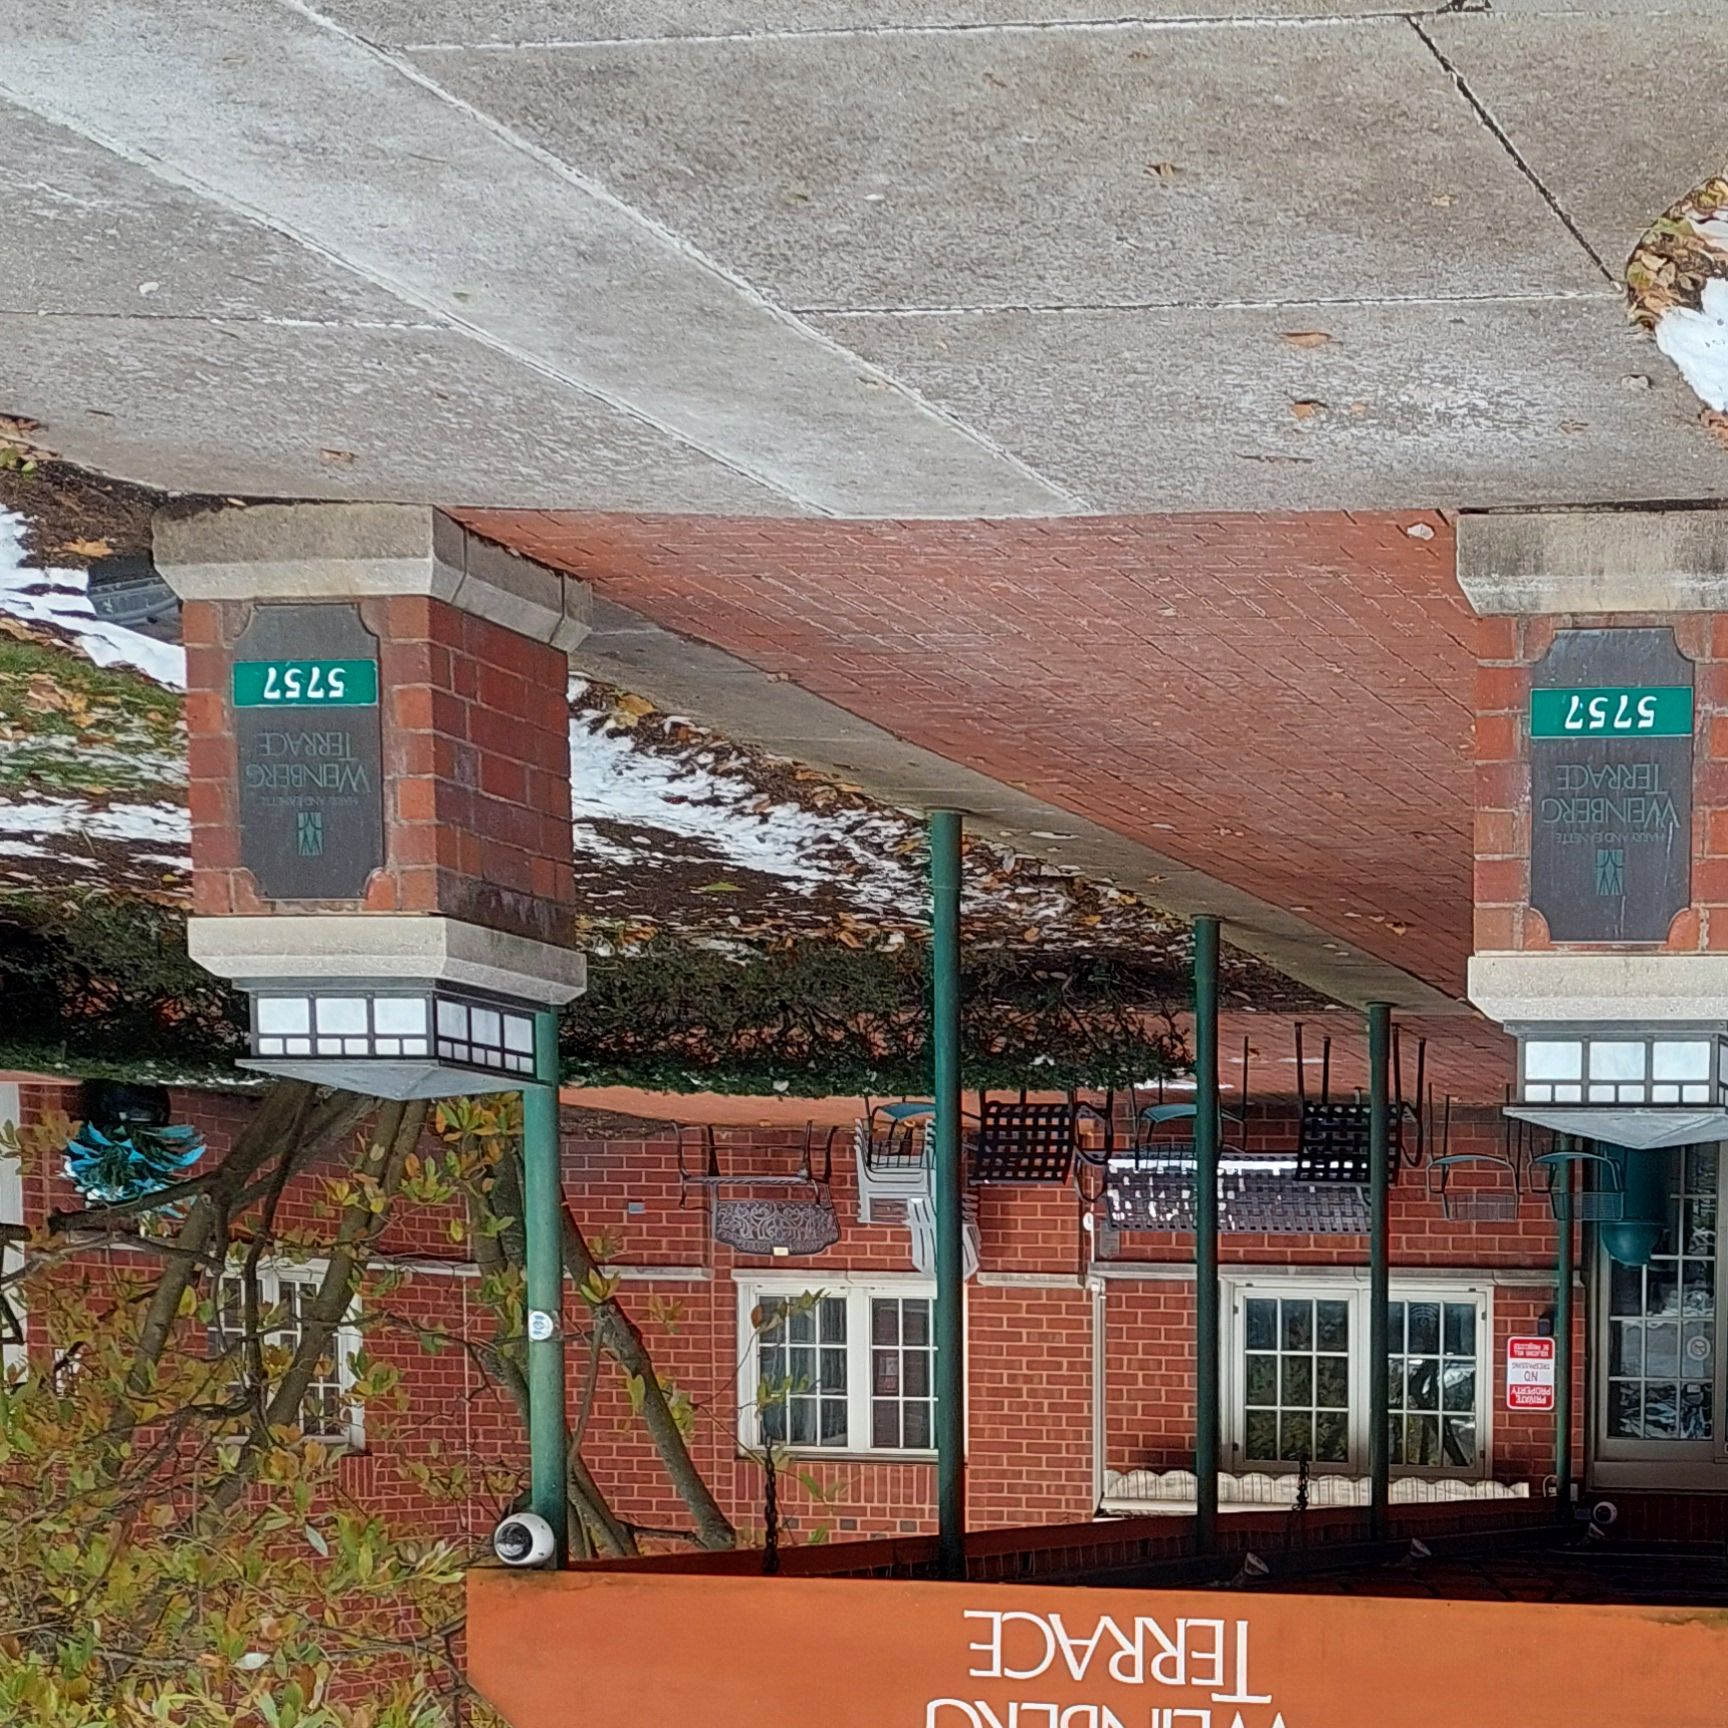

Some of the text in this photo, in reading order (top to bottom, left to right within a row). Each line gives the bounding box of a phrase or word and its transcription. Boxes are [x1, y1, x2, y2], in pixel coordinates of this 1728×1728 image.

[263, 667, 346, 699] 5757
[1564, 695, 1658, 730] 5757
[257, 731, 357, 761] TERRACE
[246, 763, 372, 793] WEINBERG
[1555, 763, 1668, 795] TERRACE
[1541, 796, 1680, 828] WEINBERG
[1604, 832, 1628, 844] AND
[1510, 1385, 1552, 1395] PROPERTY
[1523, 1370, 1539, 1382] NO
[1515, 1394, 1547, 1404] PRIVATE
[963, 1609, 1272, 1704] TERRACE
